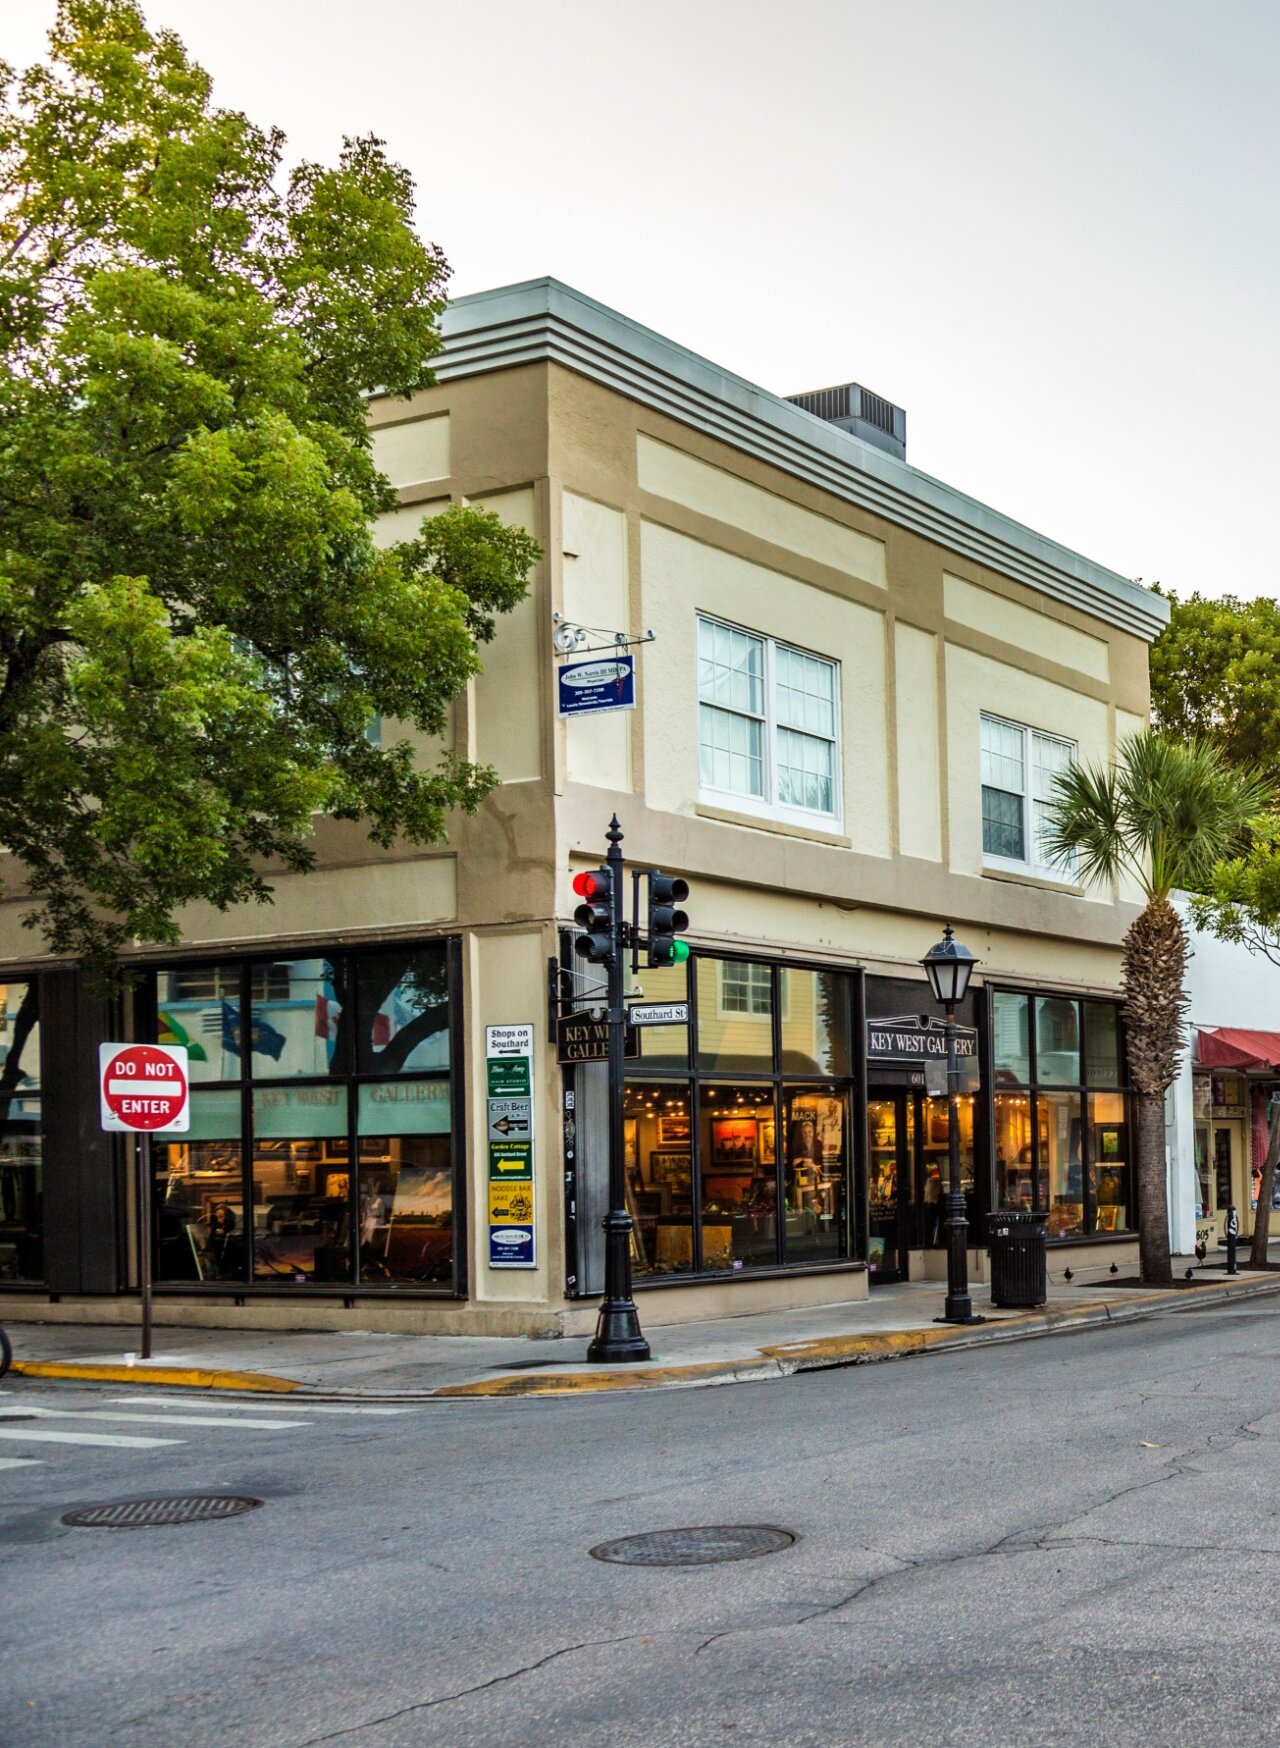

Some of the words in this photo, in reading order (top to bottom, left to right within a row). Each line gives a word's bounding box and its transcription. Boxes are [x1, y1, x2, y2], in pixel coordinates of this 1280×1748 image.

[635, 1009, 672, 1020] Southard
[675, 1007, 684, 1018] St
[491, 1030, 516, 1039] Shops
[566, 1026, 590, 1041] KEY
[491, 1039, 529, 1048] Southard
[870, 1032, 894, 1050] KEY
[895, 1033, 926, 1053] WEST
[927, 1037, 975, 1055] GALERY
[115, 1061, 136, 1075] DO
[145, 1063, 174, 1077] NOT
[259, 1090, 289, 1107] KEY
[295, 1088, 339, 1105] WEST
[370, 1080, 448, 1104] GALLERY
[122, 1099, 170, 1114] ENTER
[490, 1102, 510, 1112] Craft
[511, 1102, 528, 1111] Beer
[1196, 1229, 1209, 1241] 605
